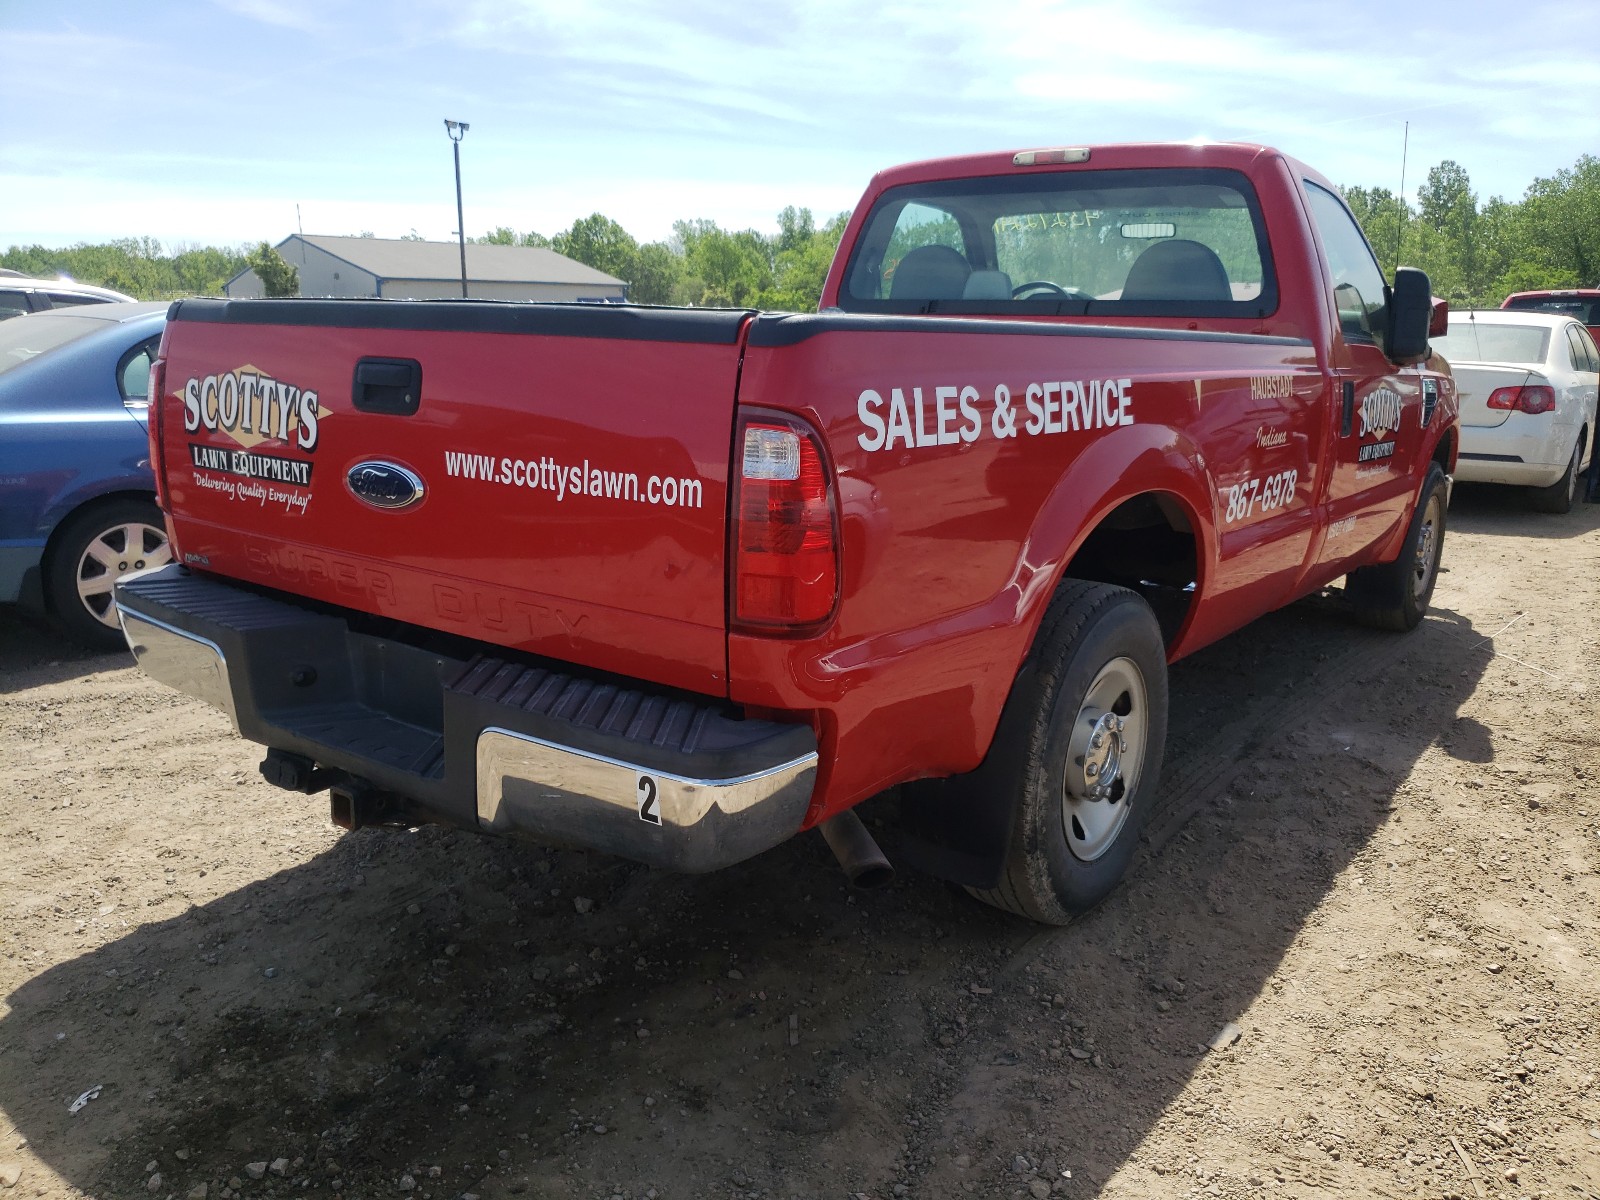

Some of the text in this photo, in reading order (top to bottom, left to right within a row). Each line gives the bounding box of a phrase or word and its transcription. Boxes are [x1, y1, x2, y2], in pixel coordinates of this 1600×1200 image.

[184, 372, 318, 453] SCOTTY'S
[1250, 375, 1294, 400] HAUBSTADT
[857, 378, 1134, 452] SALES & SERVICE
[1256, 426, 1288, 449] Indiana
[193, 446, 310, 484] LAWN EQUIPMENT
[444, 450, 703, 508] www.scottyslawn.com
[236, 482, 268, 507] Quality
[268, 488, 313, 515] Everyday"
[1225, 469, 1298, 523] 867-6978
[246, 545, 591, 650] SUPER DUTY
[638, 775, 657, 823] 2
